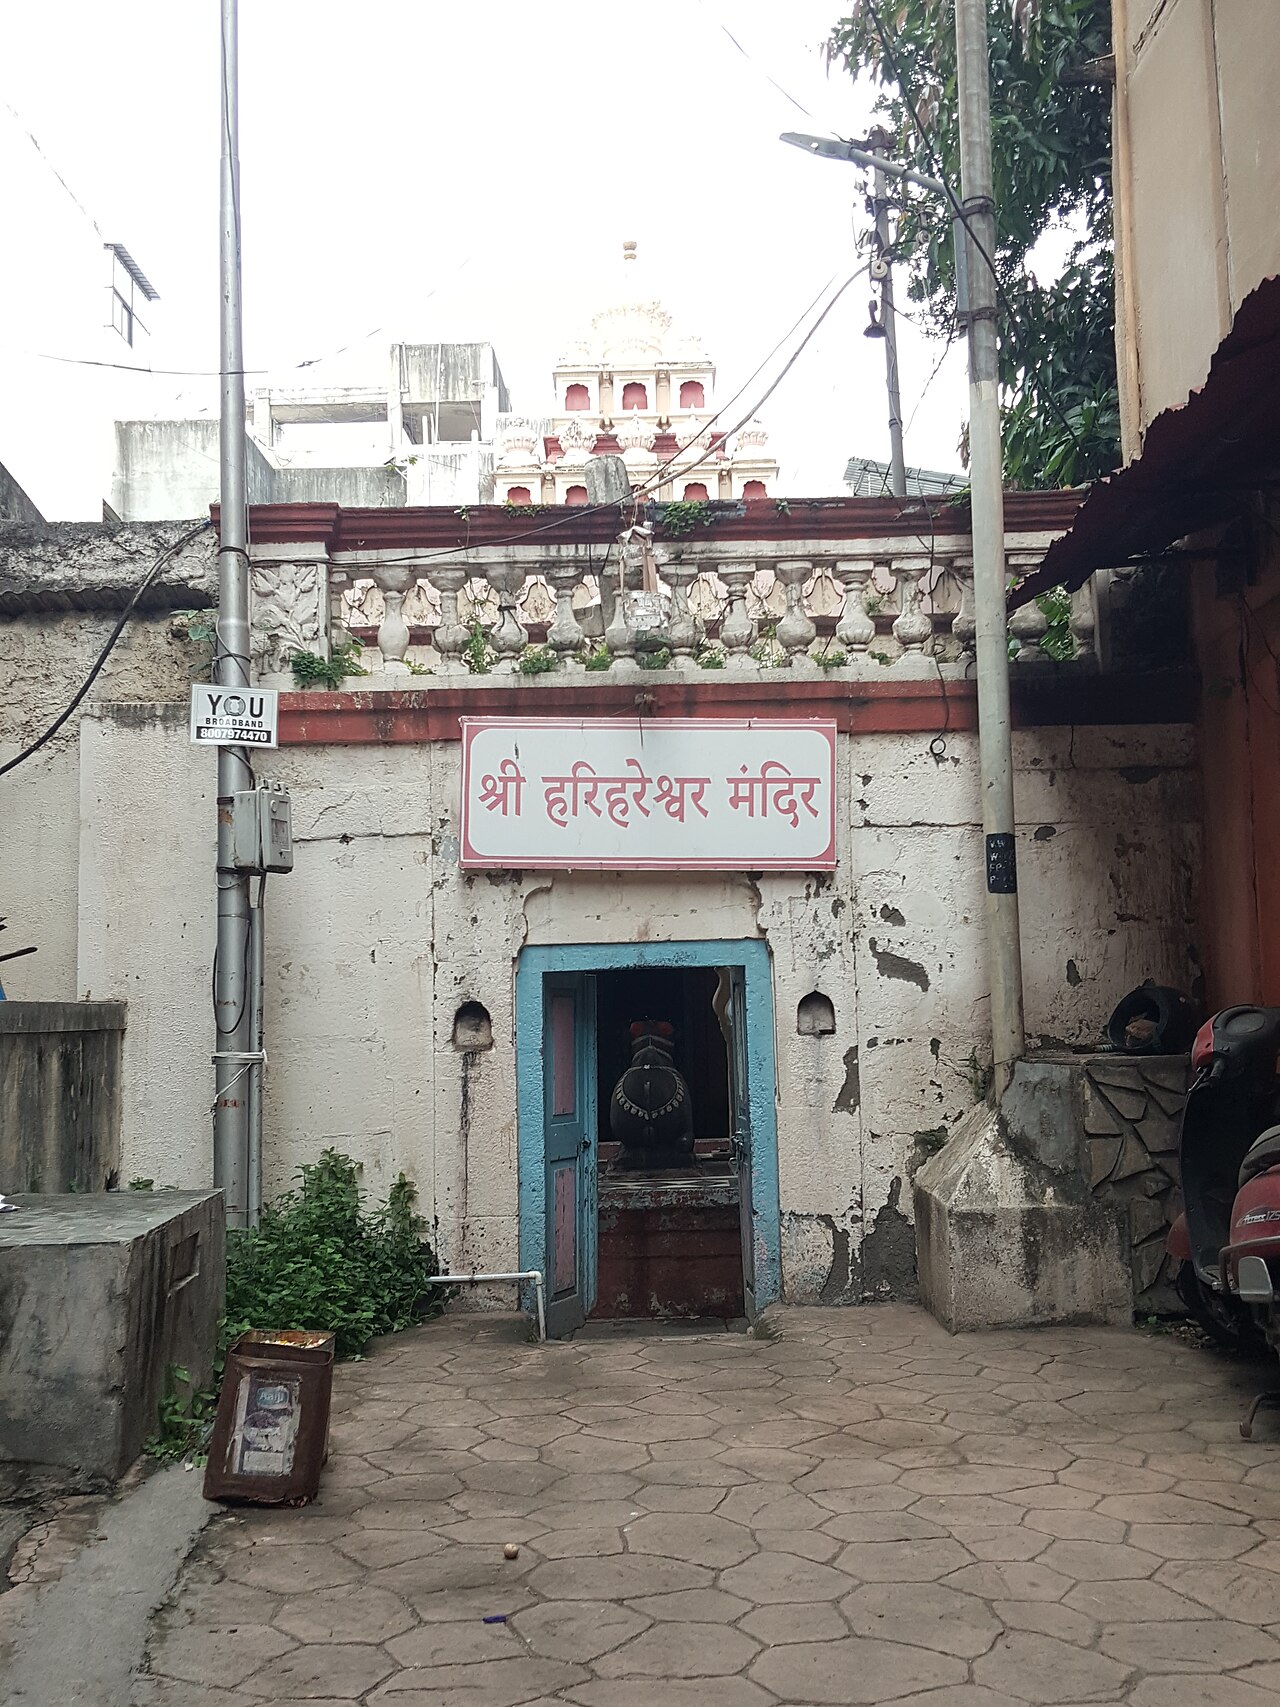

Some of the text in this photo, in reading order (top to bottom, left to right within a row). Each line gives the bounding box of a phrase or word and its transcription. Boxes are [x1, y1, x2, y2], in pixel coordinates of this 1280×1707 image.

[207, 694, 264, 718] YOU
[205, 717, 264, 728] BROADBAND
[200, 728, 268, 742] 8007974470
[478, 758, 821, 829] श्री हरिहरेश्वर मंदिर
